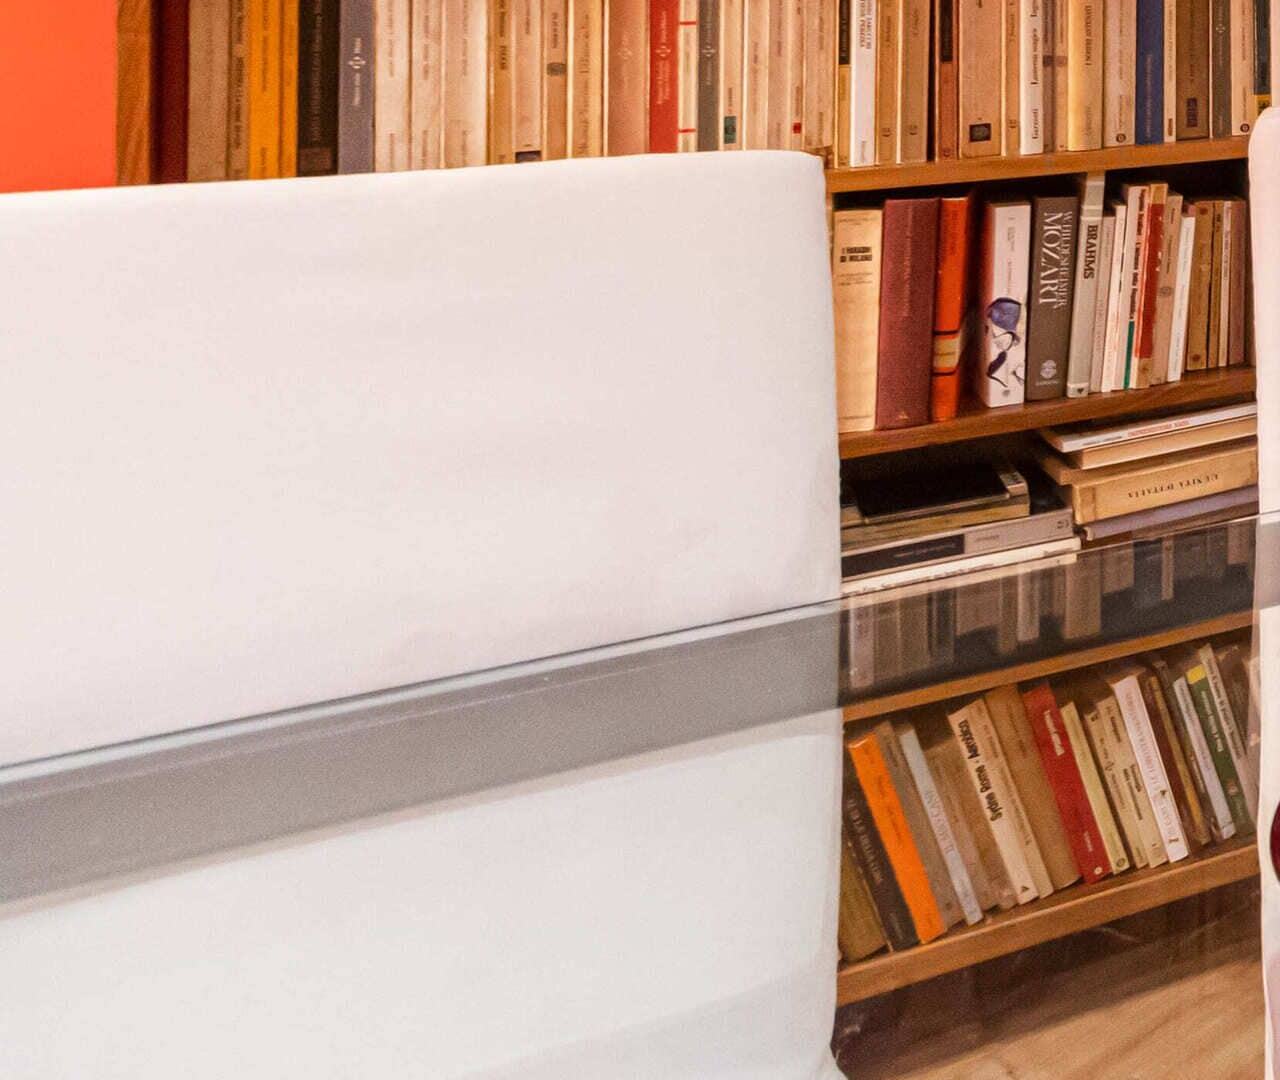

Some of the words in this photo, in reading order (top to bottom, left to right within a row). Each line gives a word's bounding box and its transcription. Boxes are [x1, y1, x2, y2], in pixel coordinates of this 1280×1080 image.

[1039, 212, 1063, 305] MOZART
[1083, 224, 1098, 280] BRAHMS
[957, 719, 980, 759] Aerobica
[974, 765, 991, 793] Rome
